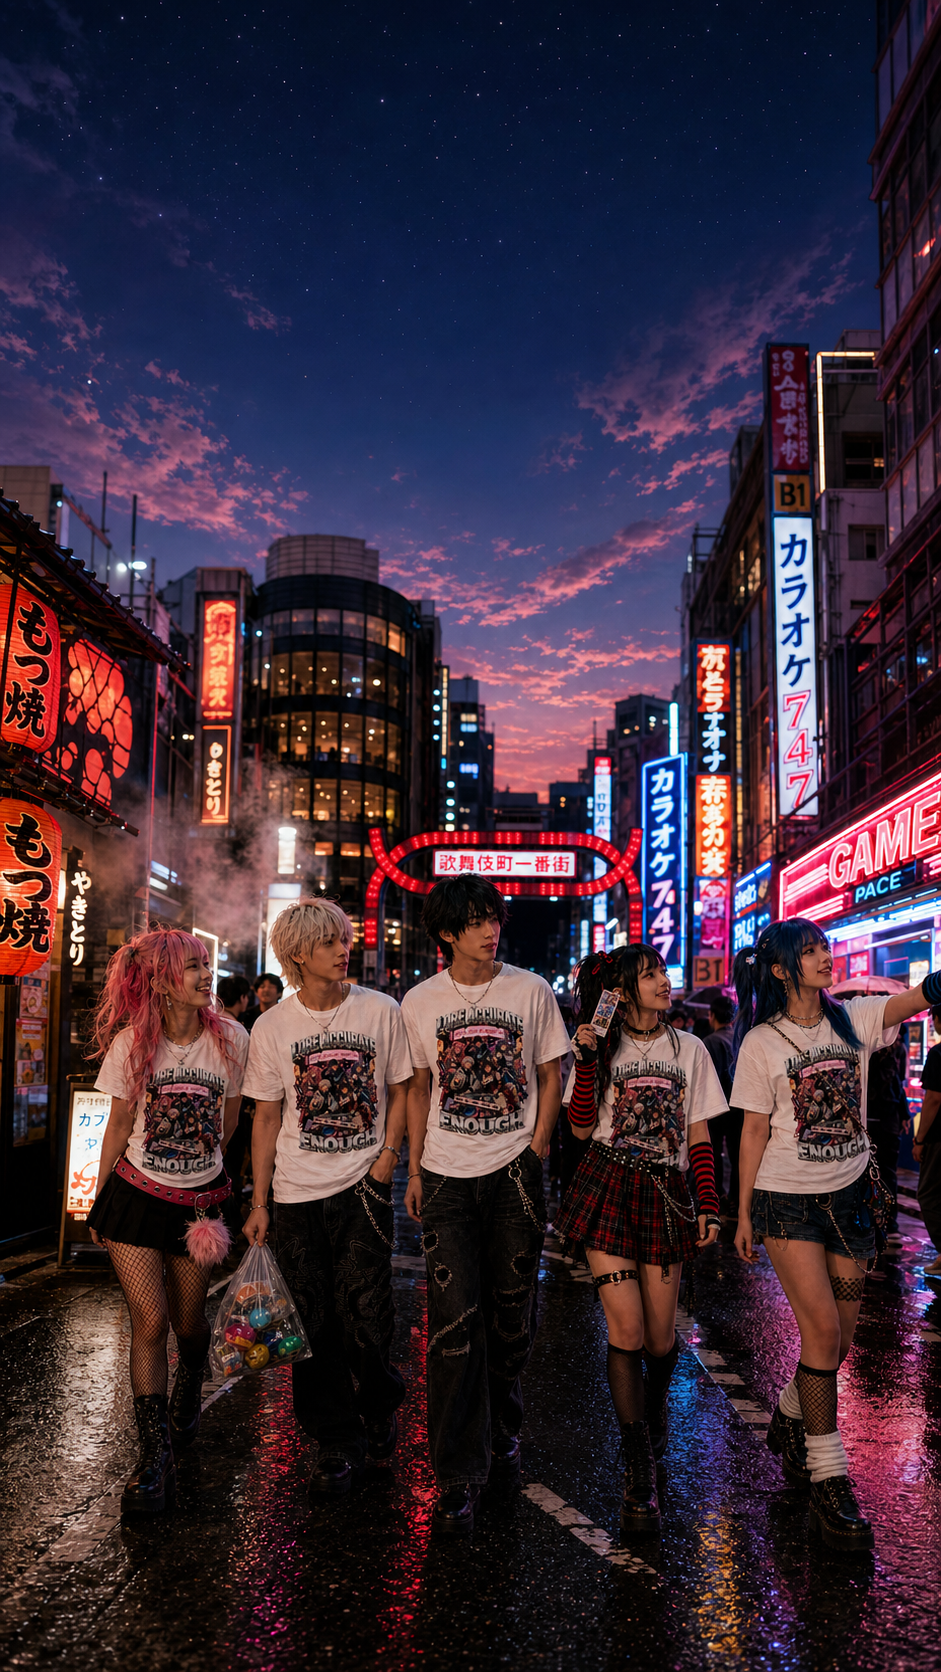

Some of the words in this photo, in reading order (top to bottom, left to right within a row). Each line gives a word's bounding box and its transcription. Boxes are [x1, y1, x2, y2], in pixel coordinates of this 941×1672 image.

[780, 482, 806, 507] B1
[4, 600, 53, 739] もつ焼
[828, 791, 941, 889] GAME
[439, 854, 570, 874] 歌舞伎町一番街
[0, 812, 53, 954] もつ焼
[854, 871, 902, 904] PACE
[68, 869, 92, 967] やきとり
[439, 1109, 526, 1136] ENOUGH
[299, 1127, 377, 1154] ENOUGH
[798, 1134, 870, 1164] ENOUGH
[142, 1151, 217, 1175] ENOUGH
